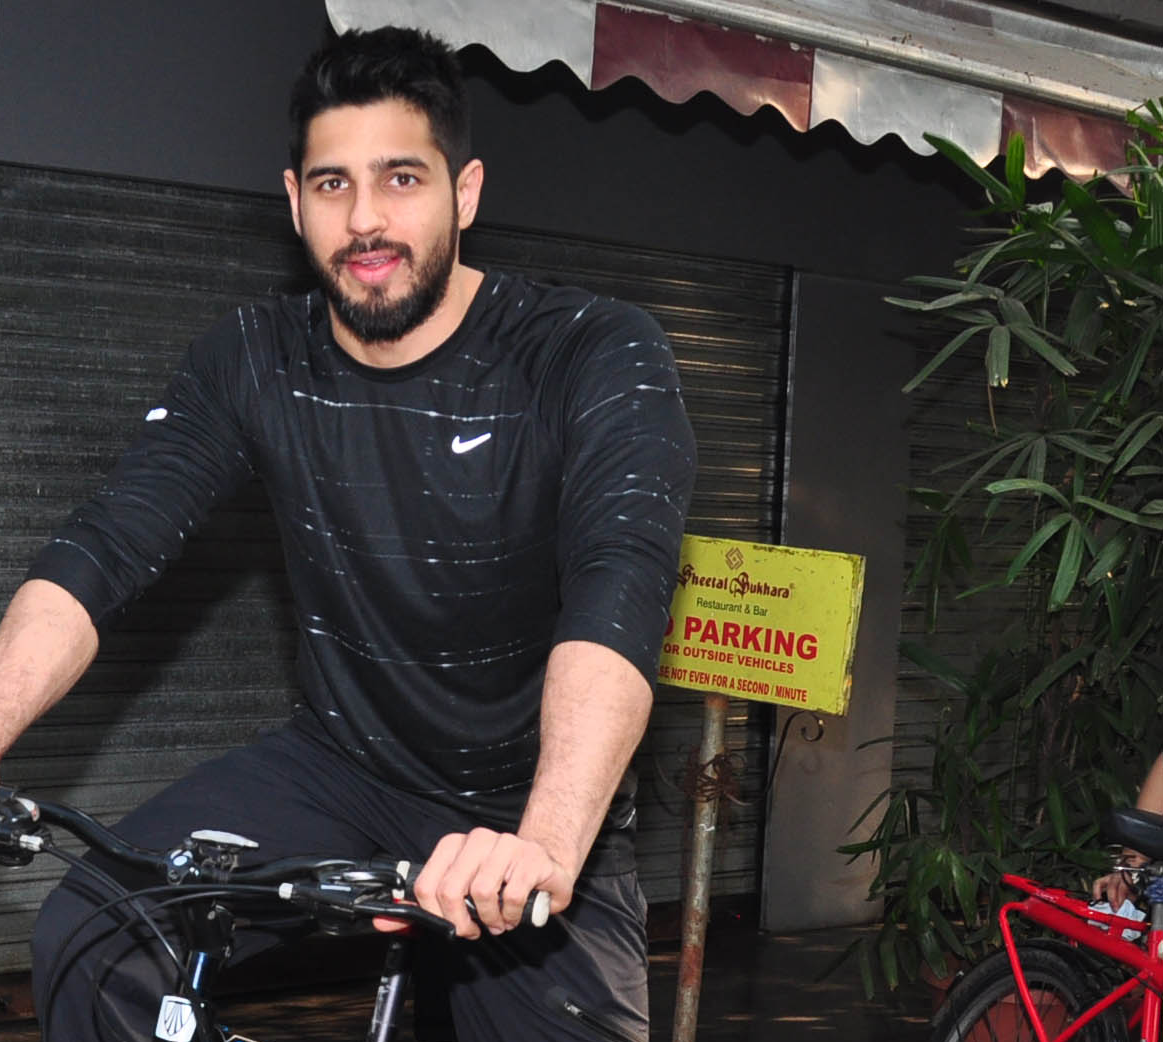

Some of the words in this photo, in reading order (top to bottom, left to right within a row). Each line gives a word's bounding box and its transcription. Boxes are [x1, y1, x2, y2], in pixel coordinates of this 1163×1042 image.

[676, 563, 728, 590] Sheetal
[729, 571, 790, 600] Bukhara
[696, 597, 743, 614] Restaurant
[744, 604, 751, 614] &
[753, 605, 769, 617] Bar
[683, 615, 819, 661] PARKING
[663, 643, 680, 655] OR
[683, 646, 734, 664] OUTSIDE
[737, 654, 795, 675] VEHICLES
[671, 667, 687, 681] NOT
[689, 670, 710, 685] EVEN
[711, 673, 728, 688] FOR
[728, 677, 735, 689] A
[736, 679, 770, 696] SECOND
[774, 685, 808, 703] MINUTE
